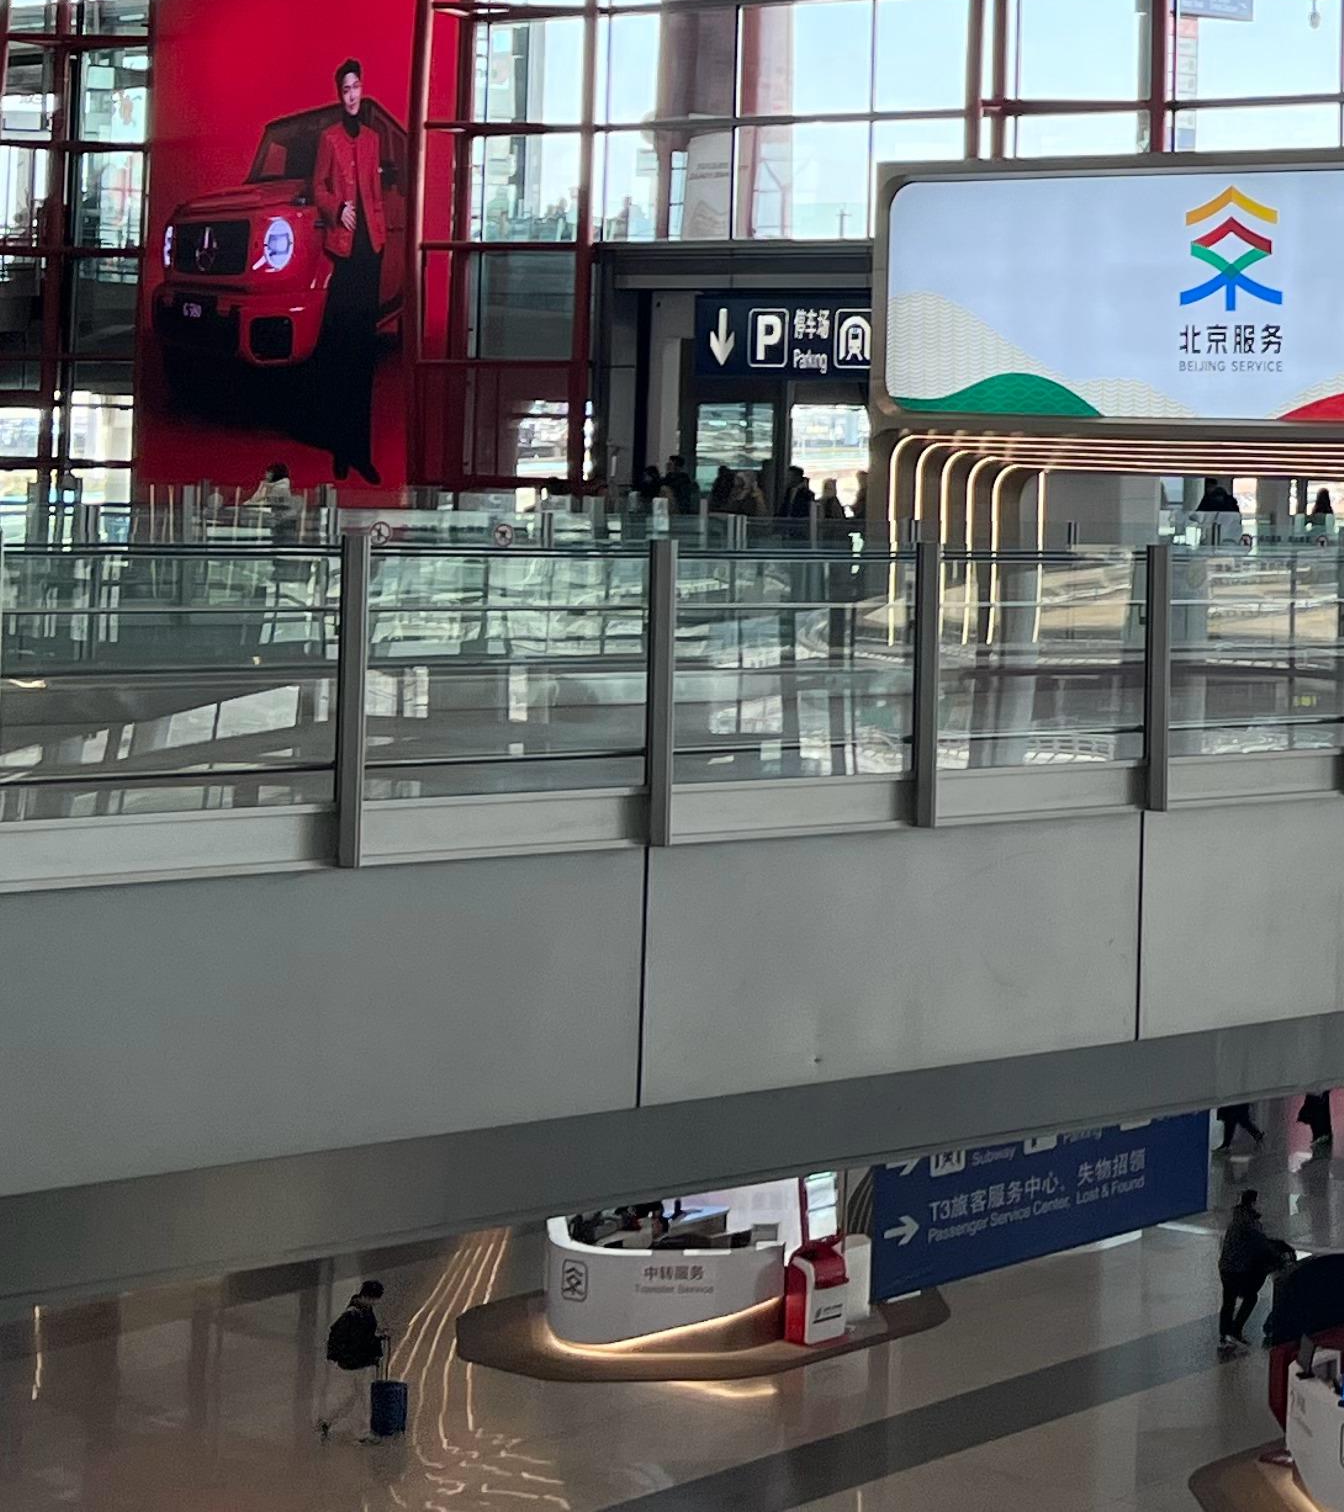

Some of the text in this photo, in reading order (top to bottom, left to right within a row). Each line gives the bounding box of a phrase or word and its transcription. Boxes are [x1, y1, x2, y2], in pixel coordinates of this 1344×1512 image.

[793, 308, 830, 339] 停车场
[1179, 324, 1283, 355] 北京服务
[793, 348, 828, 375] Parking
[1179, 361, 1283, 372] BEIJING SERVICE
[972, 1146, 1017, 1166] Subway
[928, 1217, 989, 1244] Passenger
[990, 1205, 1031, 1227] Service
[1076, 1186, 1099, 1205] Lost
[1111, 1175, 1145, 1195] Found
